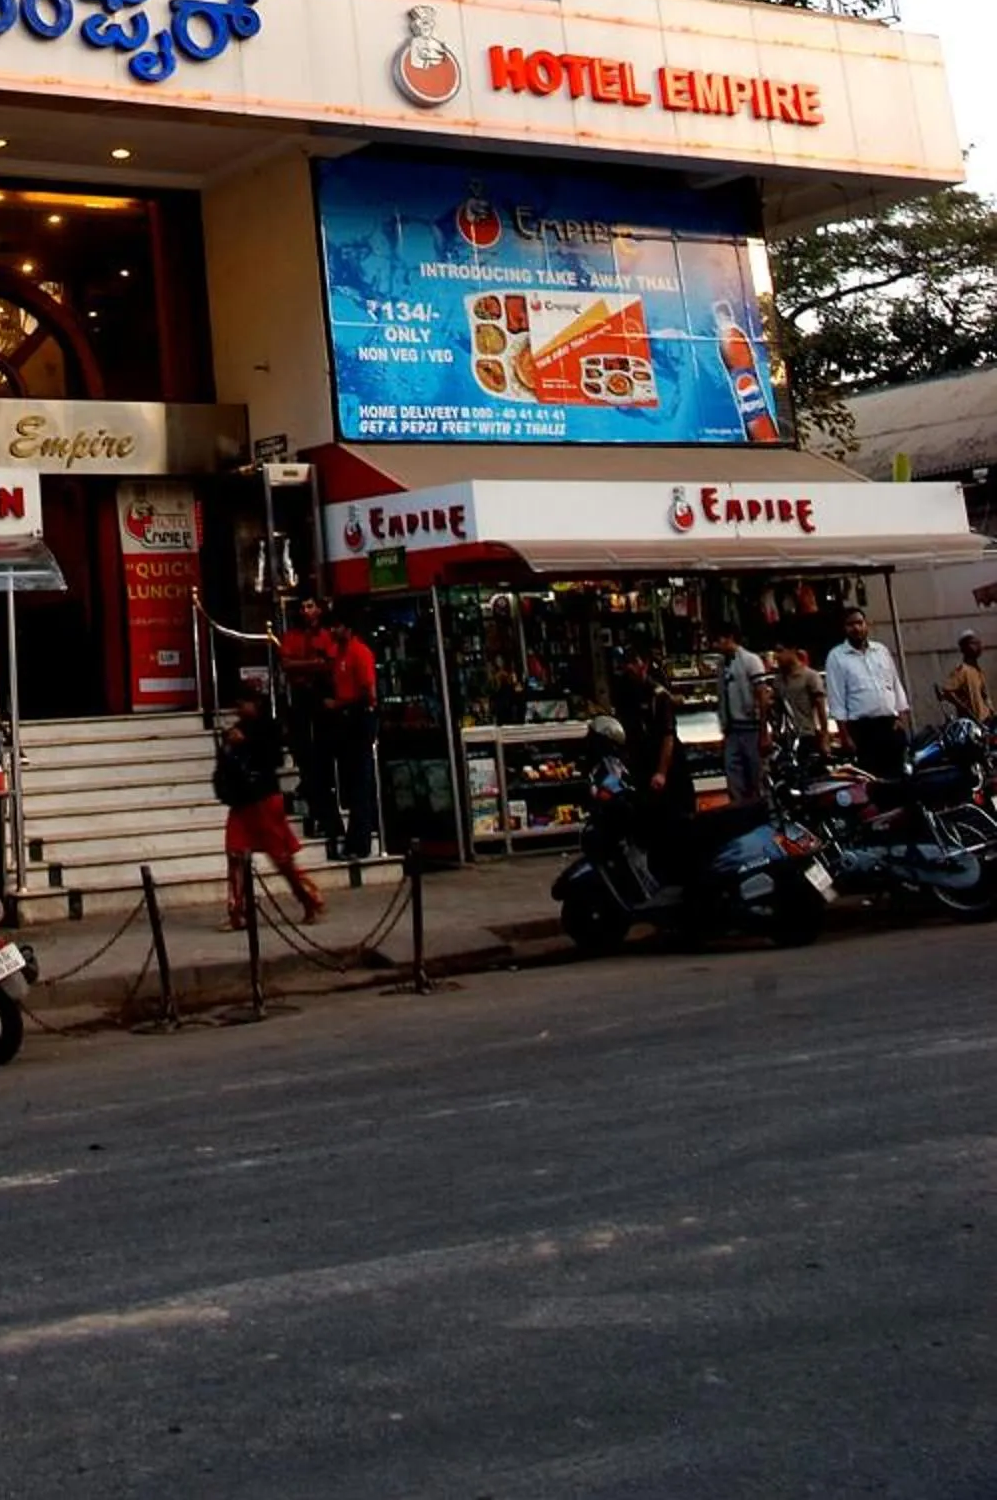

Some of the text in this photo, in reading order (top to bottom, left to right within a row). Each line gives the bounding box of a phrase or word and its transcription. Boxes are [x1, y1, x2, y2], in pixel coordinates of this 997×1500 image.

[488, 46, 824, 125] HOTEL EMPIRE
[513, 204, 640, 252] EMPIR
[420, 262, 532, 285] INTRODUCING
[536, 269, 577, 287] TAKE
[384, 326, 432, 343] ONLY
[358, 346, 389, 361] NON
[391, 347, 419, 363] VEG
[427, 349, 455, 364] VEG
[359, 404, 398, 419] HOME
[400, 405, 459, 420] DELIVERY
[359, 420, 386, 434] GET
[8, 414, 136, 468] Empire
[368, 505, 467, 540] EMPIRE
[699, 487, 816, 534] EMPIRE
